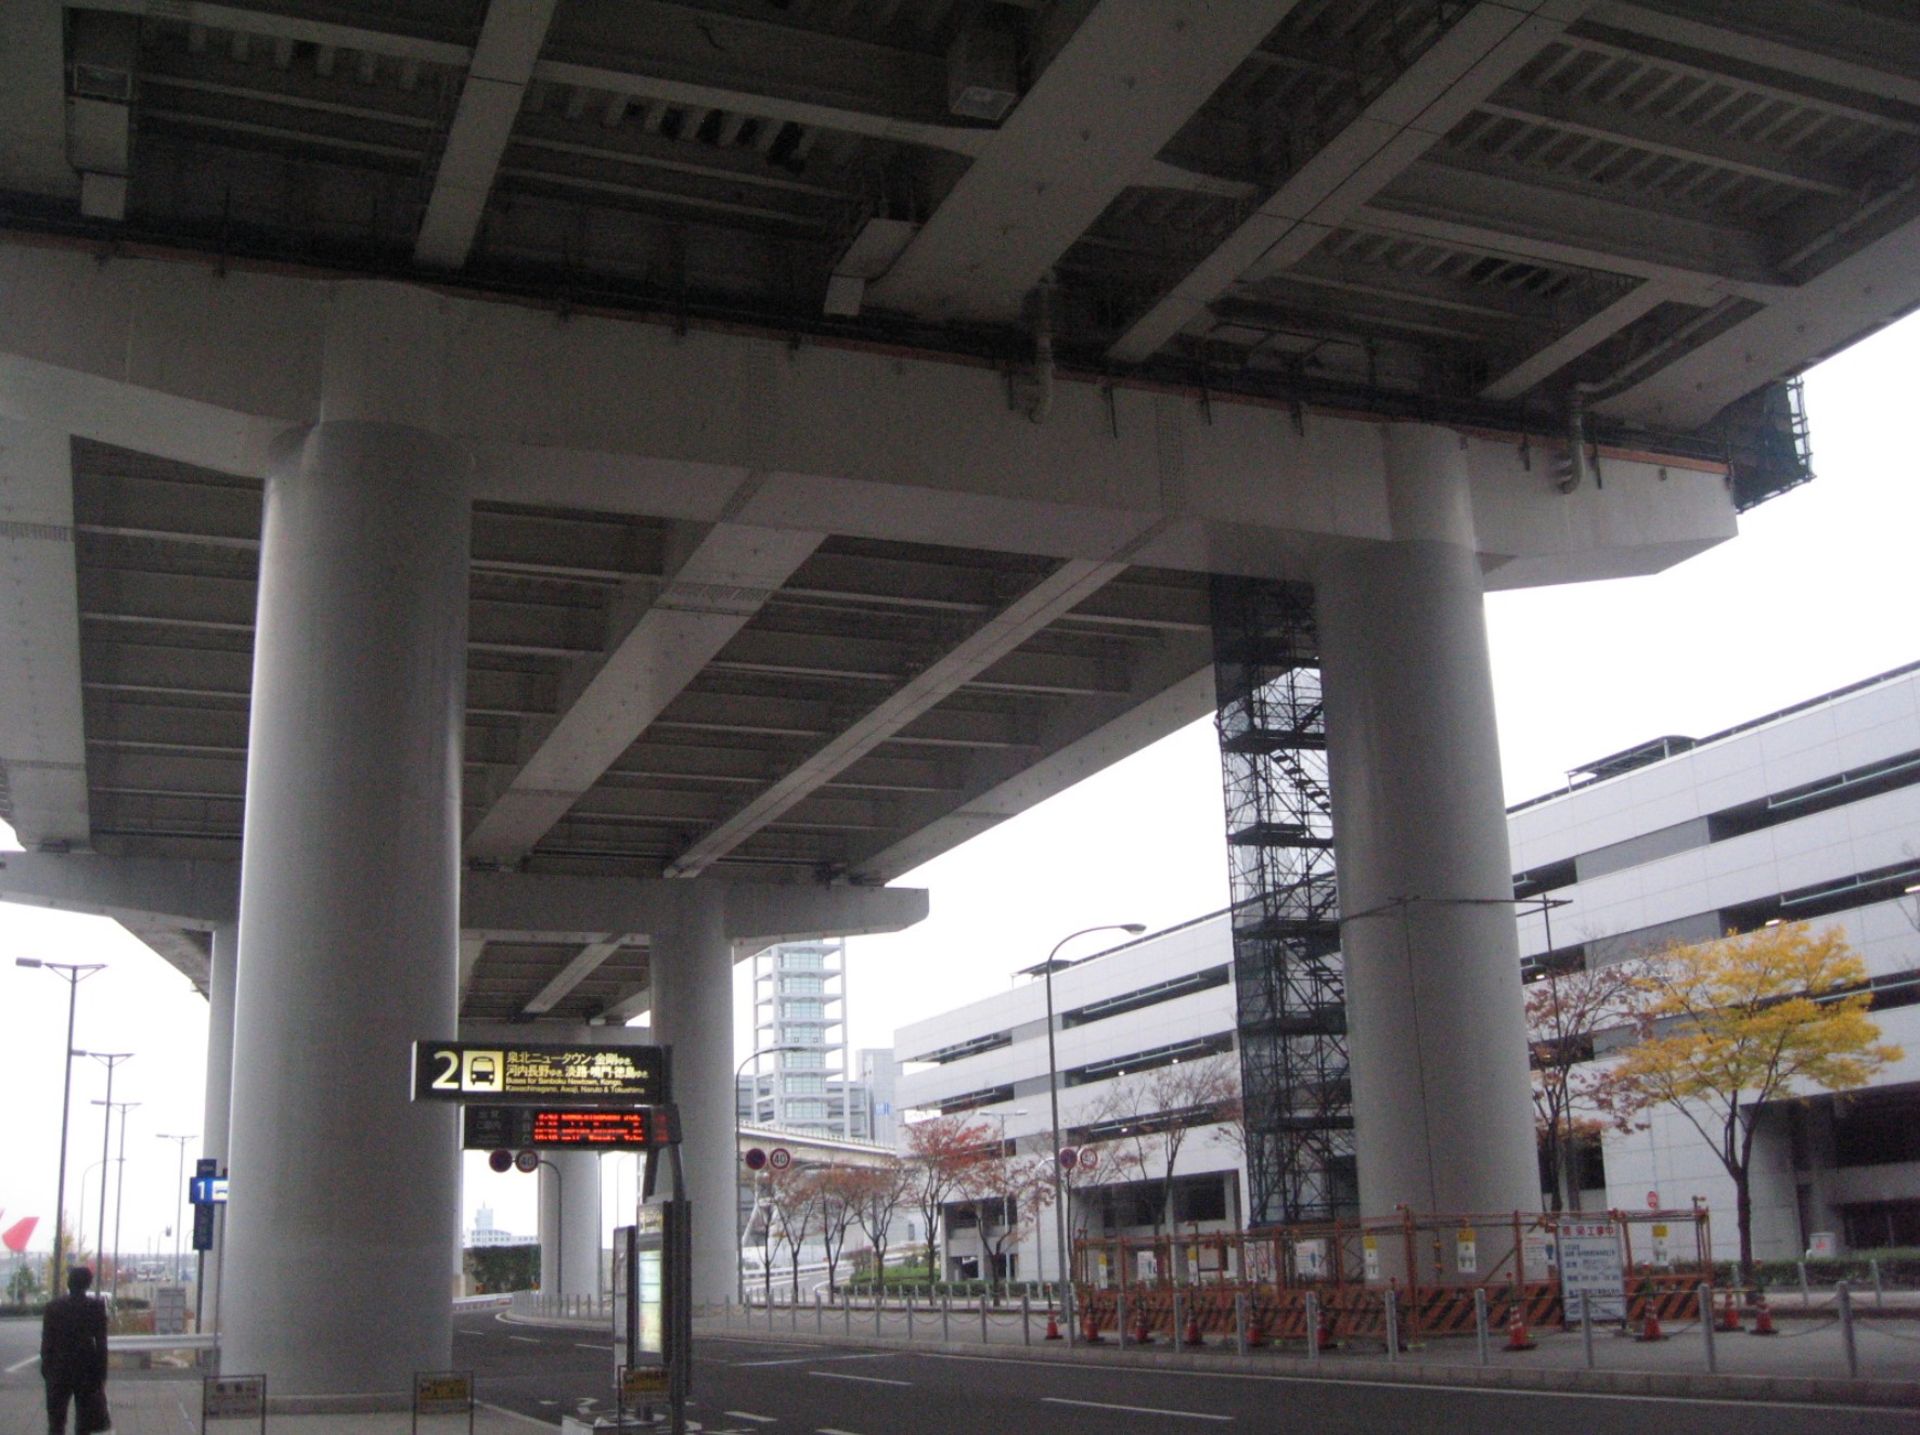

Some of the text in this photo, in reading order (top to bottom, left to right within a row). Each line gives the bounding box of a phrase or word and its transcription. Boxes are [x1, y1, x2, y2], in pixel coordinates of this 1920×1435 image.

[431, 1050, 460, 1089] 2
[775, 1154, 788, 1164] 40
[198, 1181, 206, 1200] 1
